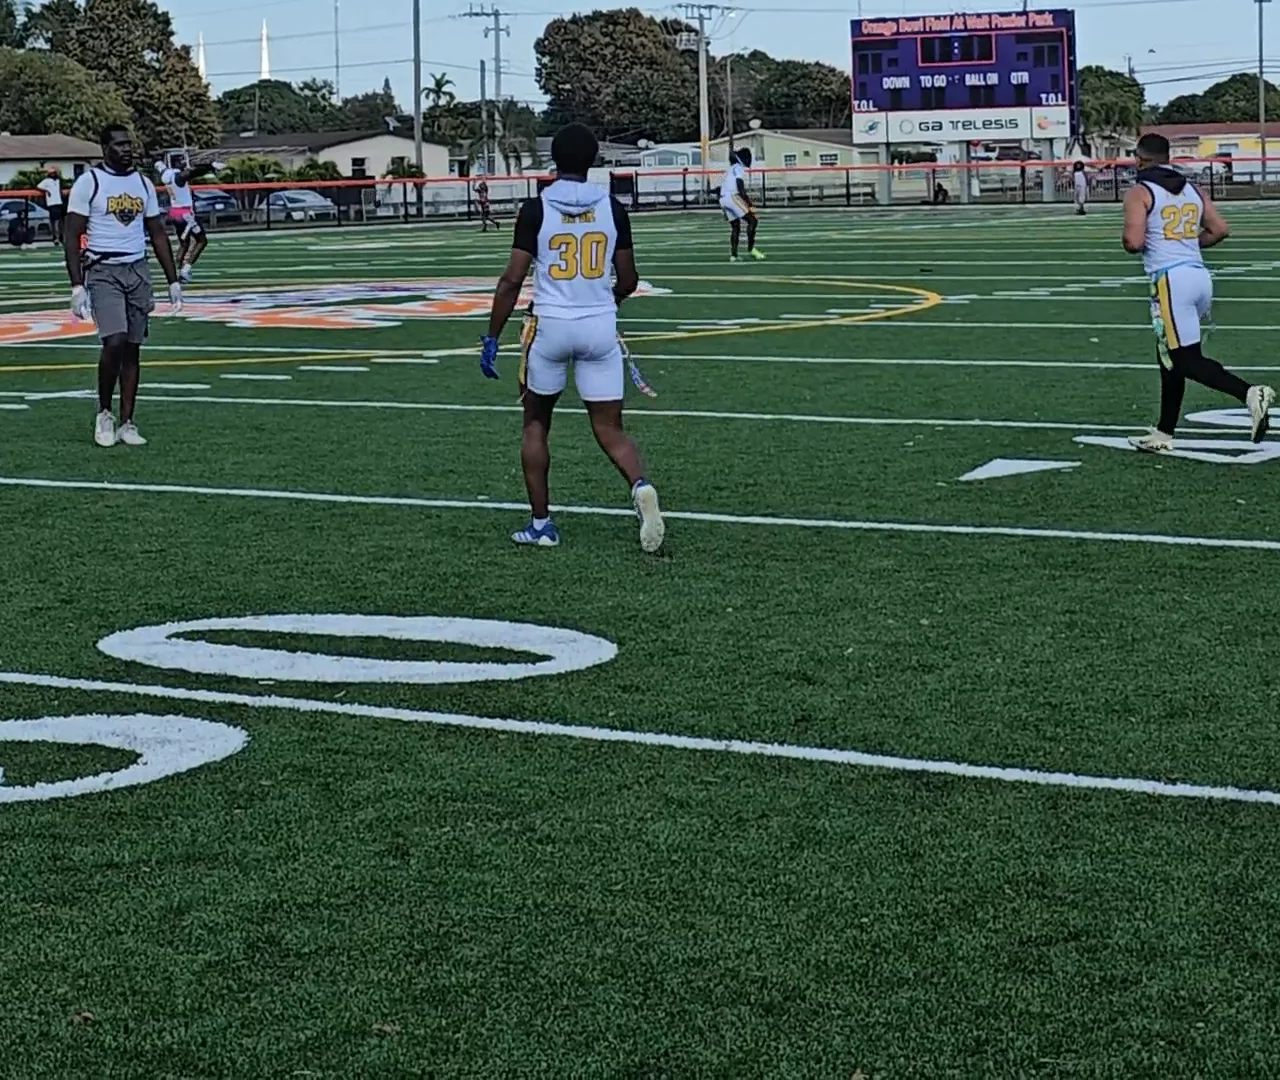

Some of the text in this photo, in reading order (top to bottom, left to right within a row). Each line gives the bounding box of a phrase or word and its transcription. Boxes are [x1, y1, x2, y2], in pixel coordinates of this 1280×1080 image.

[862, 20, 897, 36] Orange
[882, 76, 910, 89] DOWN
[919, 74, 947, 88] TO GO
[965, 72, 999, 86] BALL ON
[1010, 71, 1029, 85] QTR
[1161, 203, 1199, 240] 22
[548, 231, 608, 280] 30
